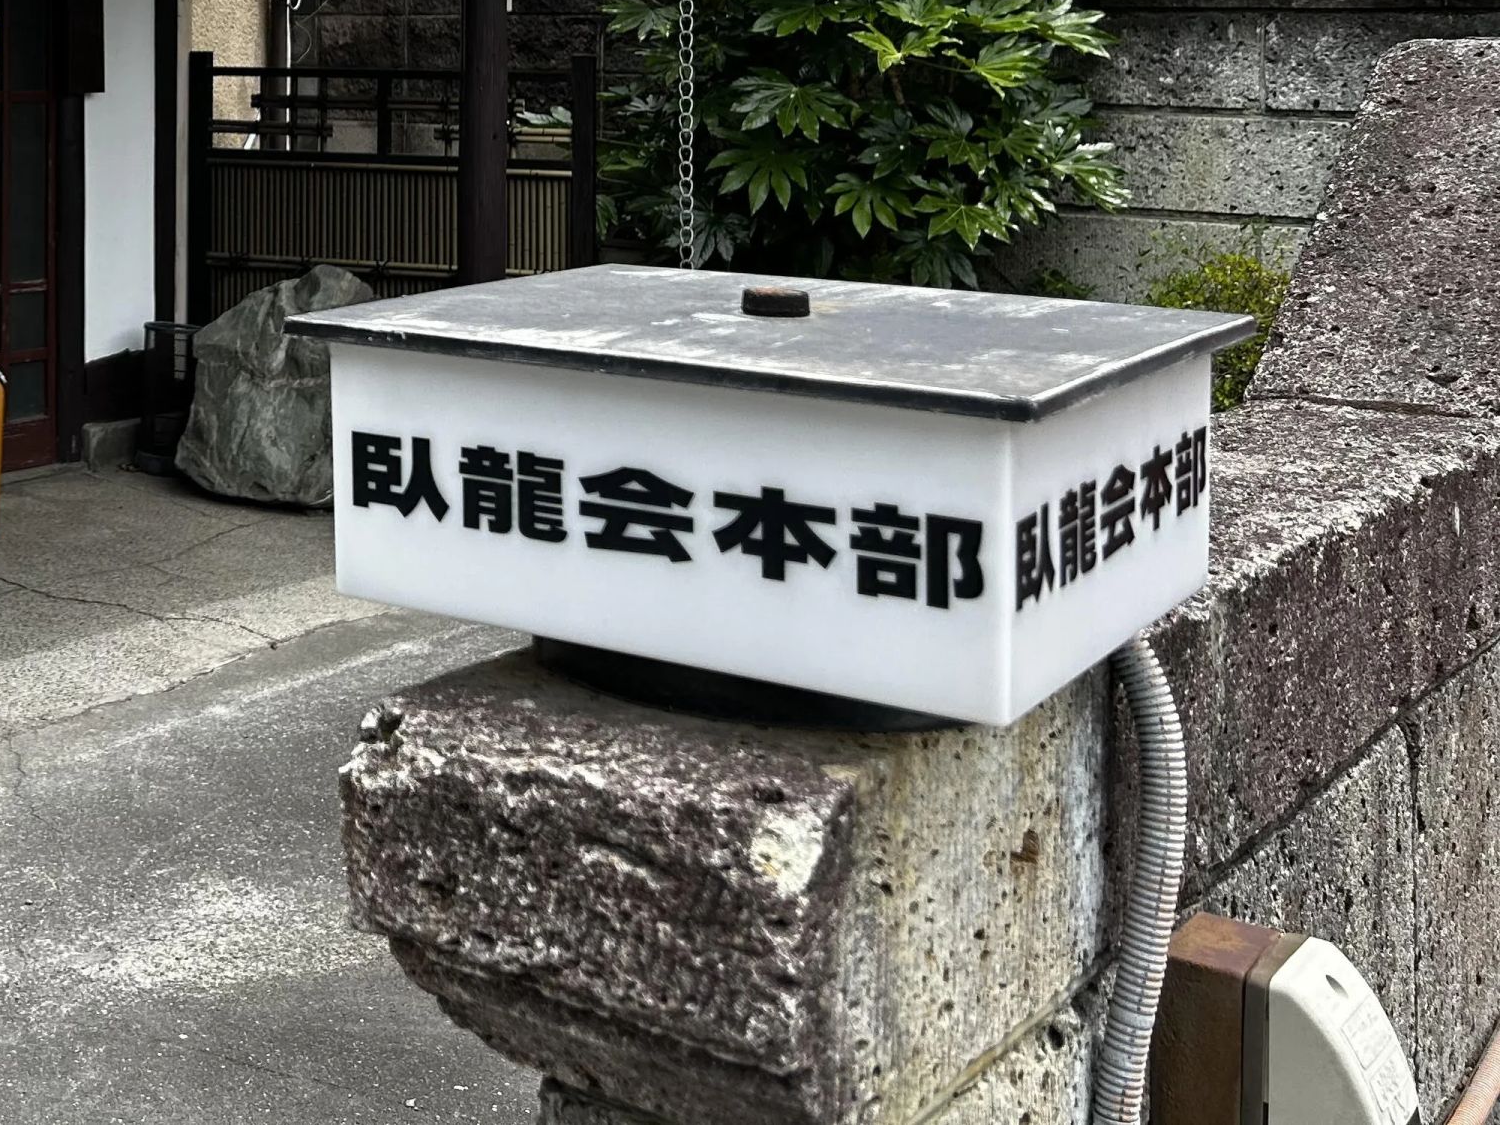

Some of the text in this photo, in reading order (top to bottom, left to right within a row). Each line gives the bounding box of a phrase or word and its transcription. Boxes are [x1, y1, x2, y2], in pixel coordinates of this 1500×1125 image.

[351, 430, 985, 610] 臥龍会本部
[1016, 426, 1207, 612] 臥龍会本部
